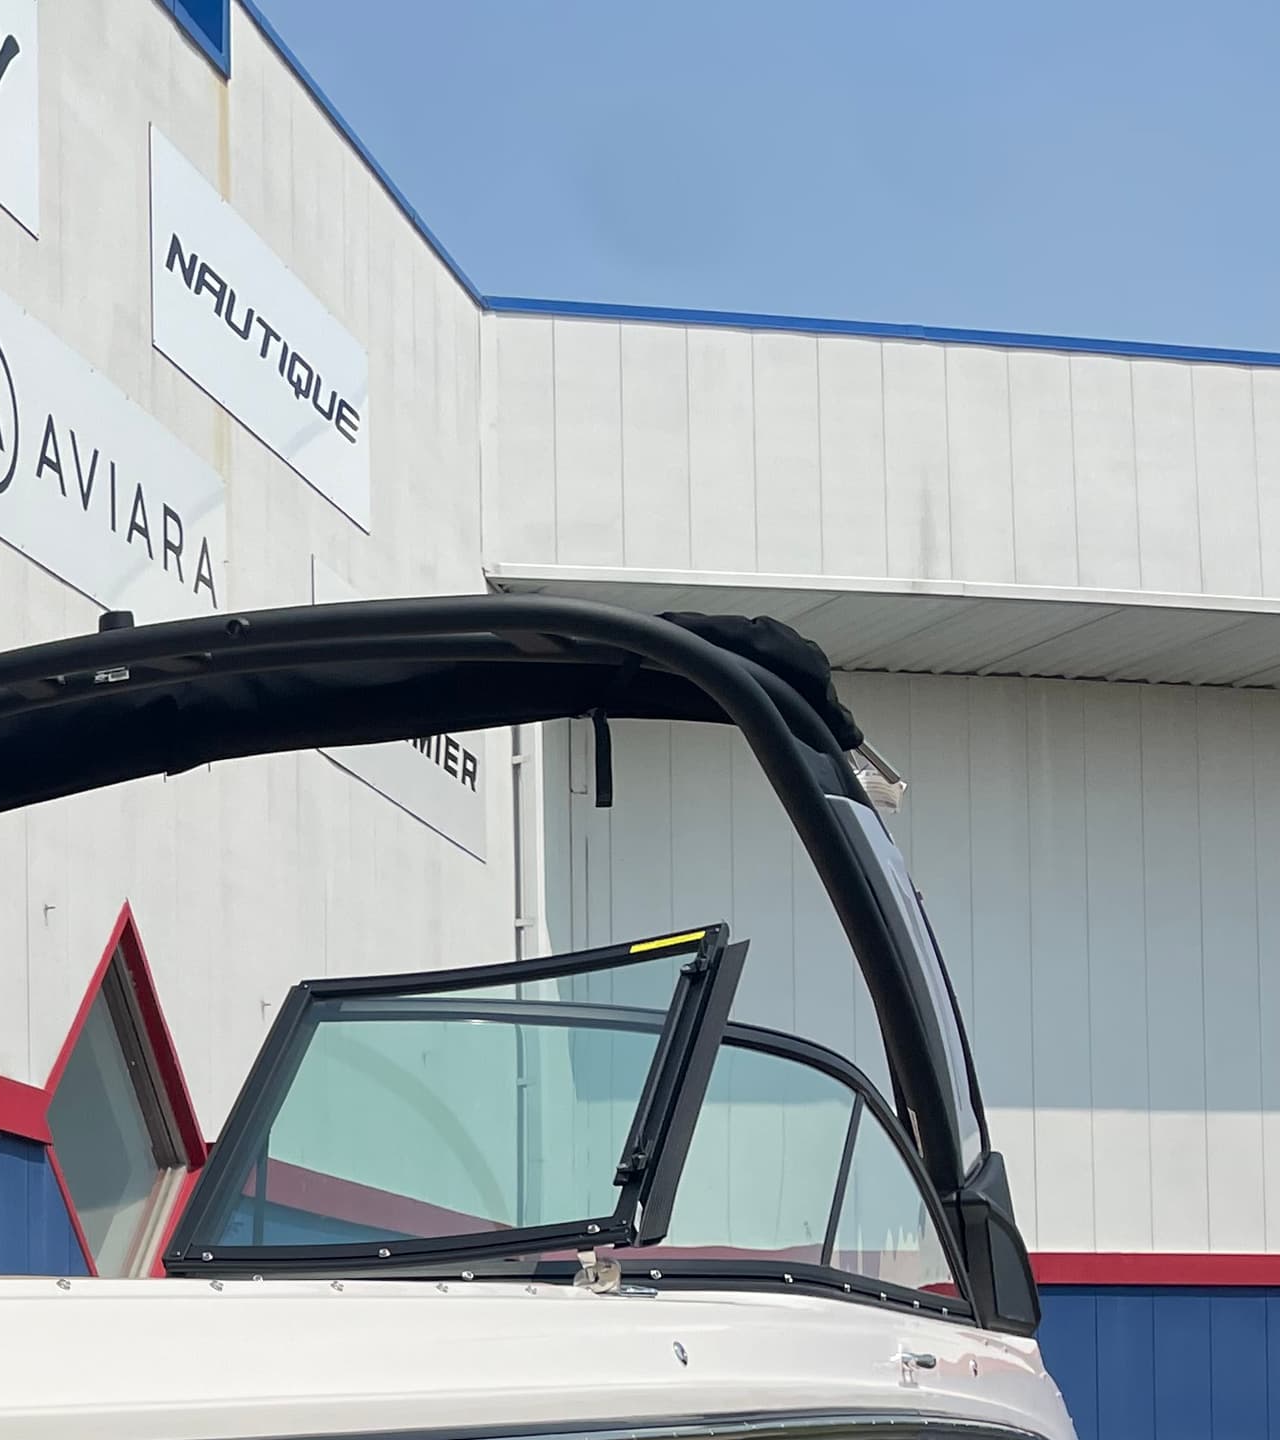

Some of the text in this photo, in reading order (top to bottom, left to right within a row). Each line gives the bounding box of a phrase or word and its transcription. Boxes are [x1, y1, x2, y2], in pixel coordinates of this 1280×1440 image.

[165, 232, 361, 444] NAUTIQUE
[35, 413, 218, 609] AVIARA
[405, 734, 478, 793] MIER
